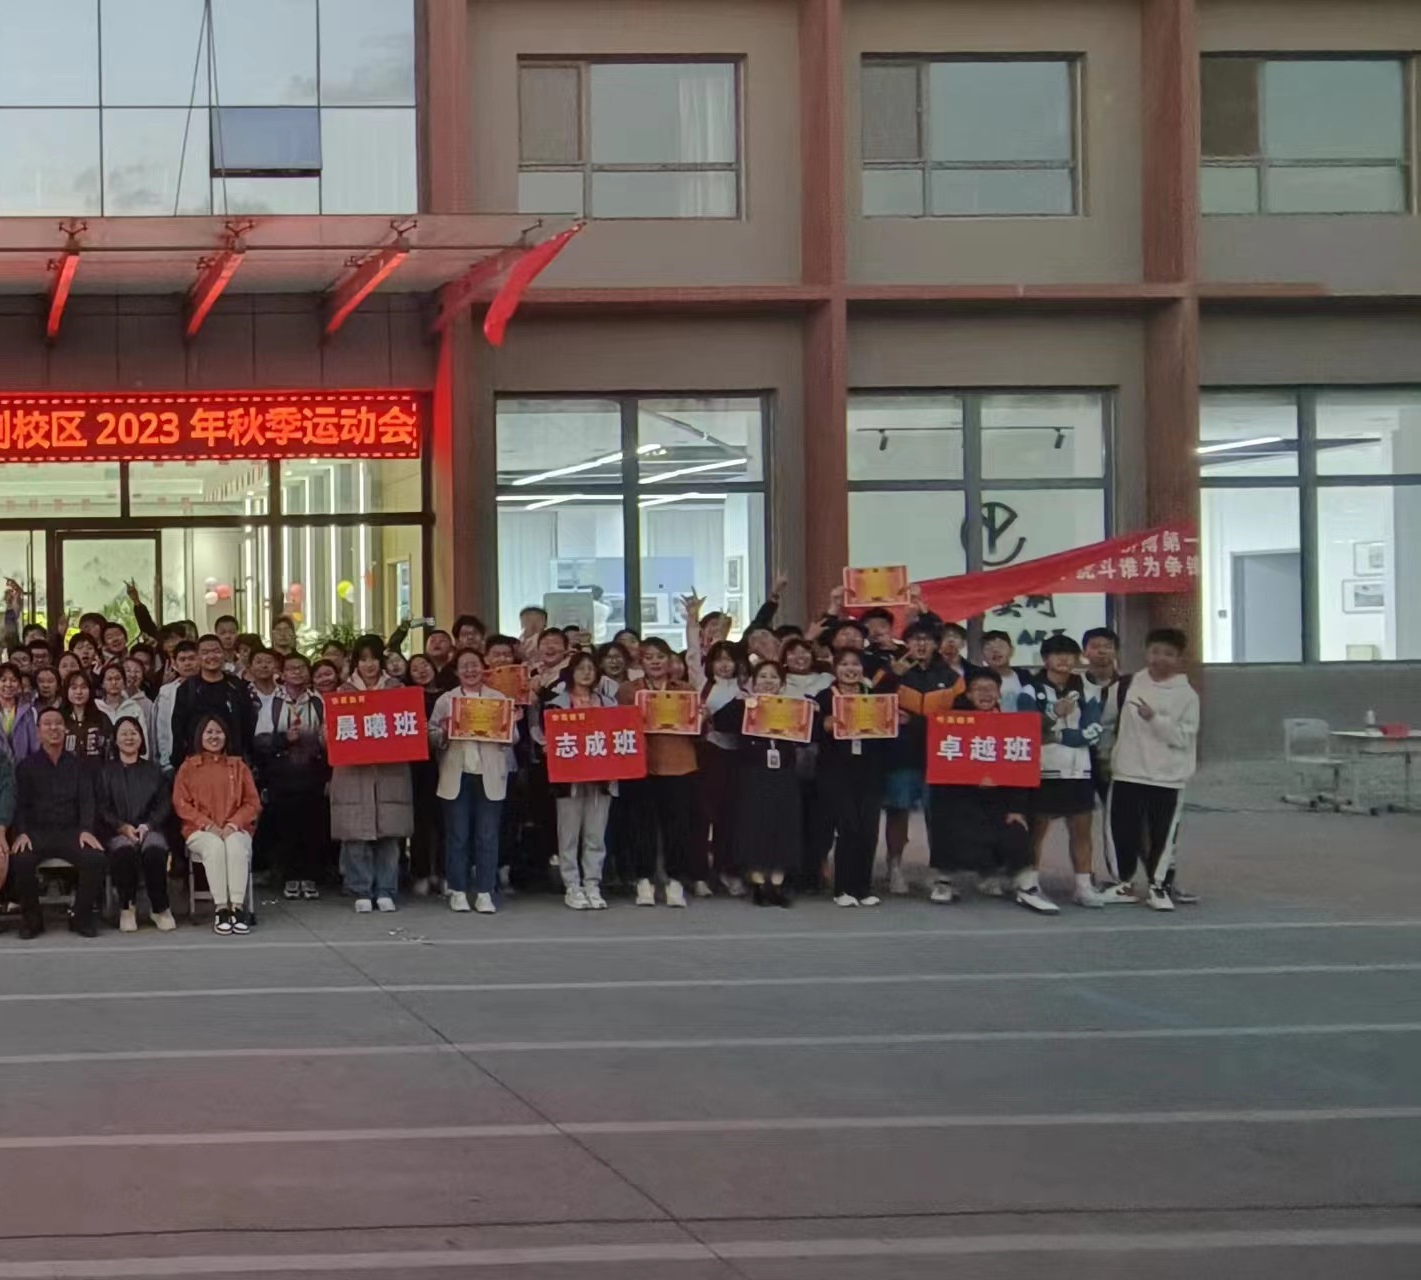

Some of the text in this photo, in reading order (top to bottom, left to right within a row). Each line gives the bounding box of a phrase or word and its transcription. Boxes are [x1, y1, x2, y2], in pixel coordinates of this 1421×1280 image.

[96, 412, 178, 446] 2023
[190, 406, 414, 446] 年秋季运动会
[336, 711, 418, 741] 晨曦班
[555, 729, 637, 758] 志成班
[936, 735, 1032, 762] 卓越班
